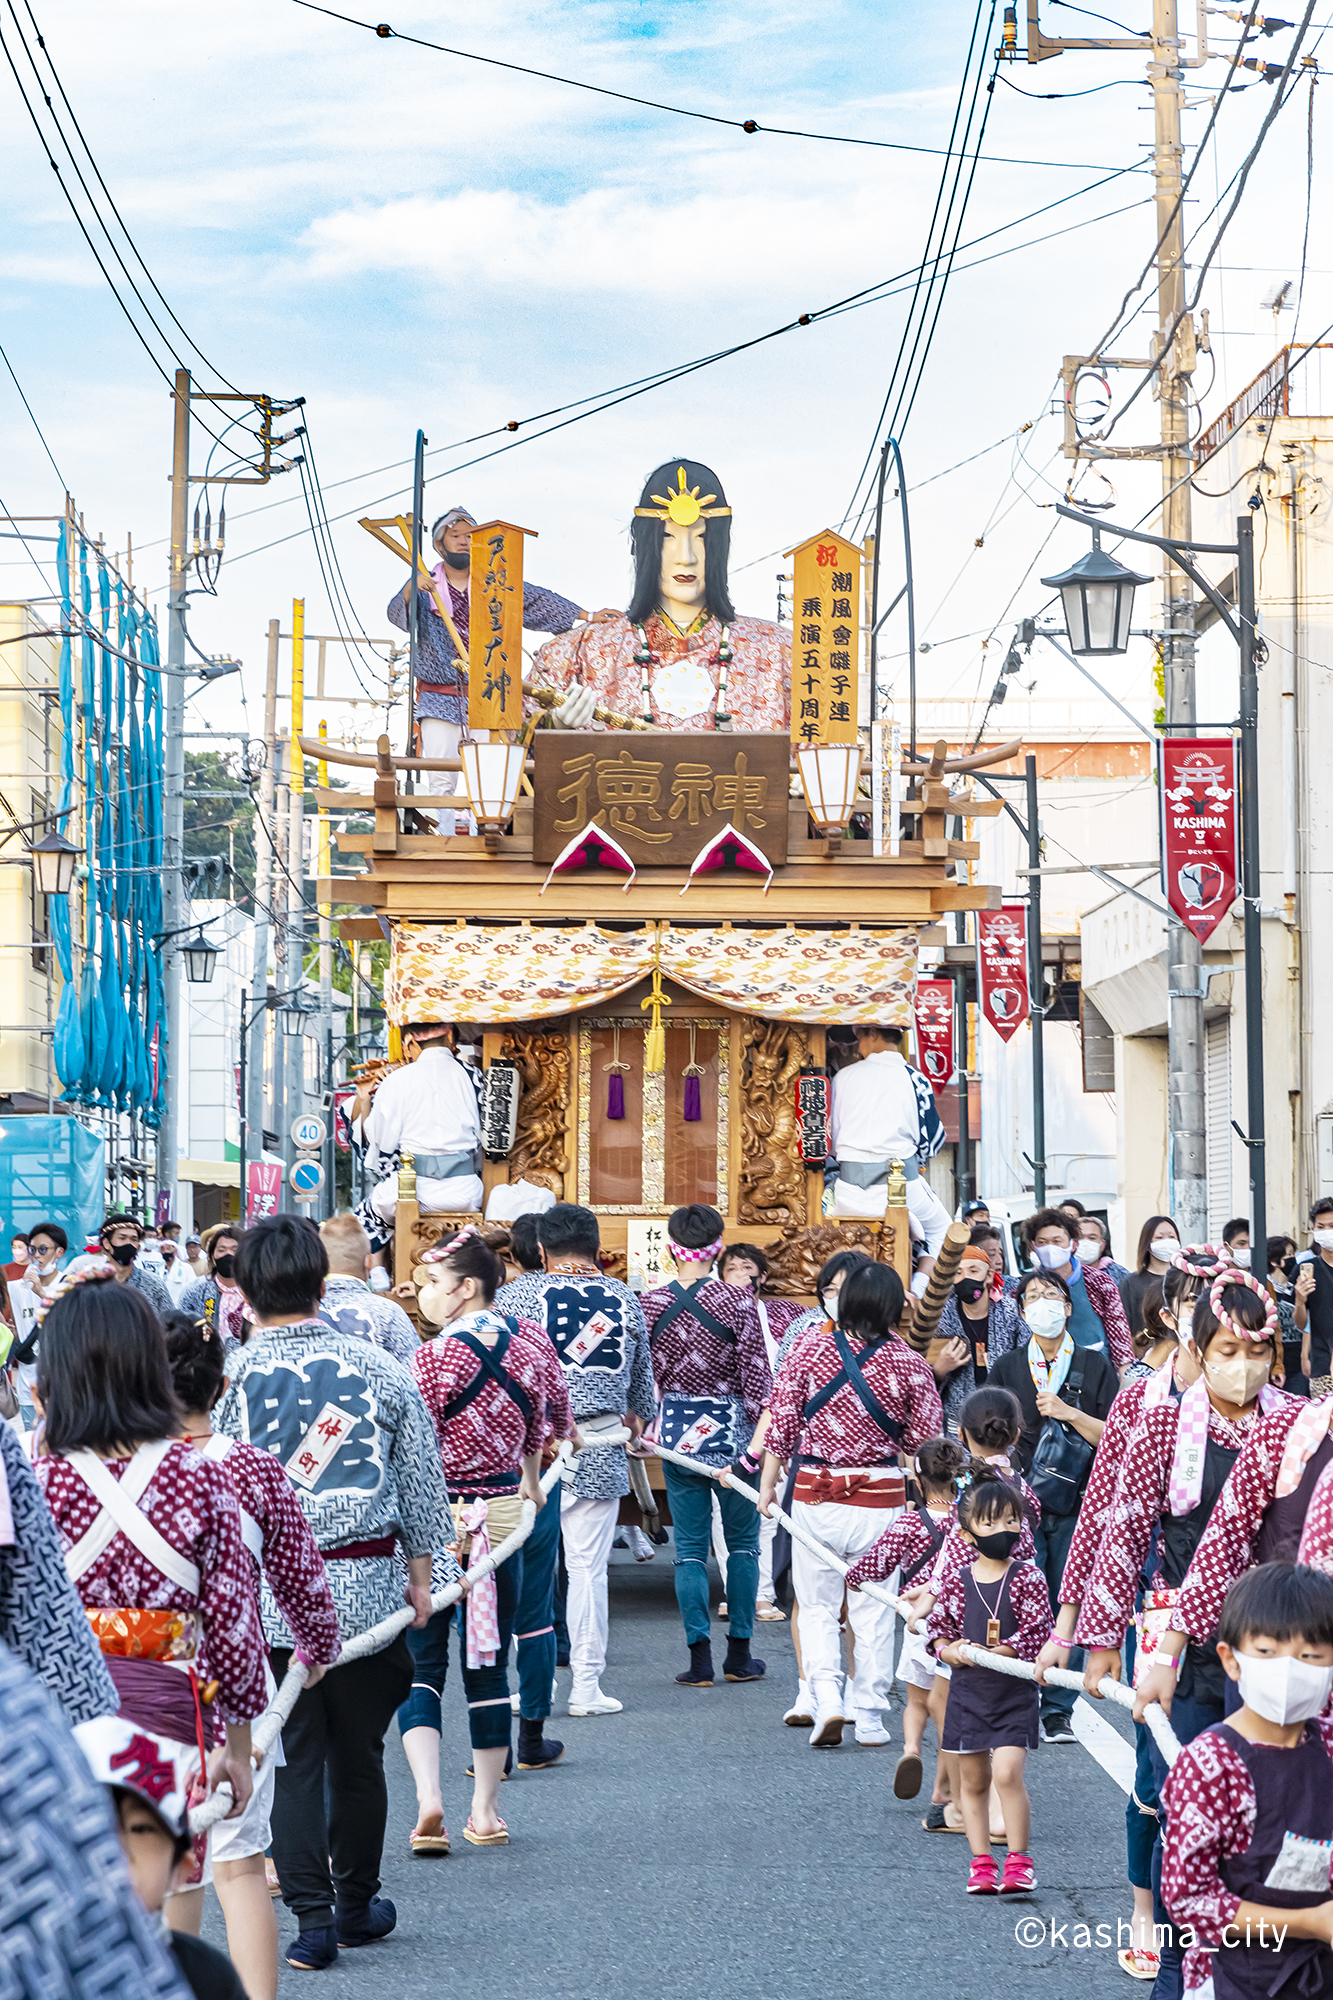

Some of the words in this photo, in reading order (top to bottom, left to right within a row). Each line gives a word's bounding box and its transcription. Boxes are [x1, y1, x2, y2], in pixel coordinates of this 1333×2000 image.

[816, 544, 838, 567] 祝
[1173, 816, 1226, 829] KASHIMA
[985, 957, 1021, 966] KASHIMA
[300, 1125, 318, 1139] 40
[645, 1226, 661, 1273] 松竹梅
[575, 1321, 606, 1356] 仲町
[298, 1416, 343, 1475] 仲町
